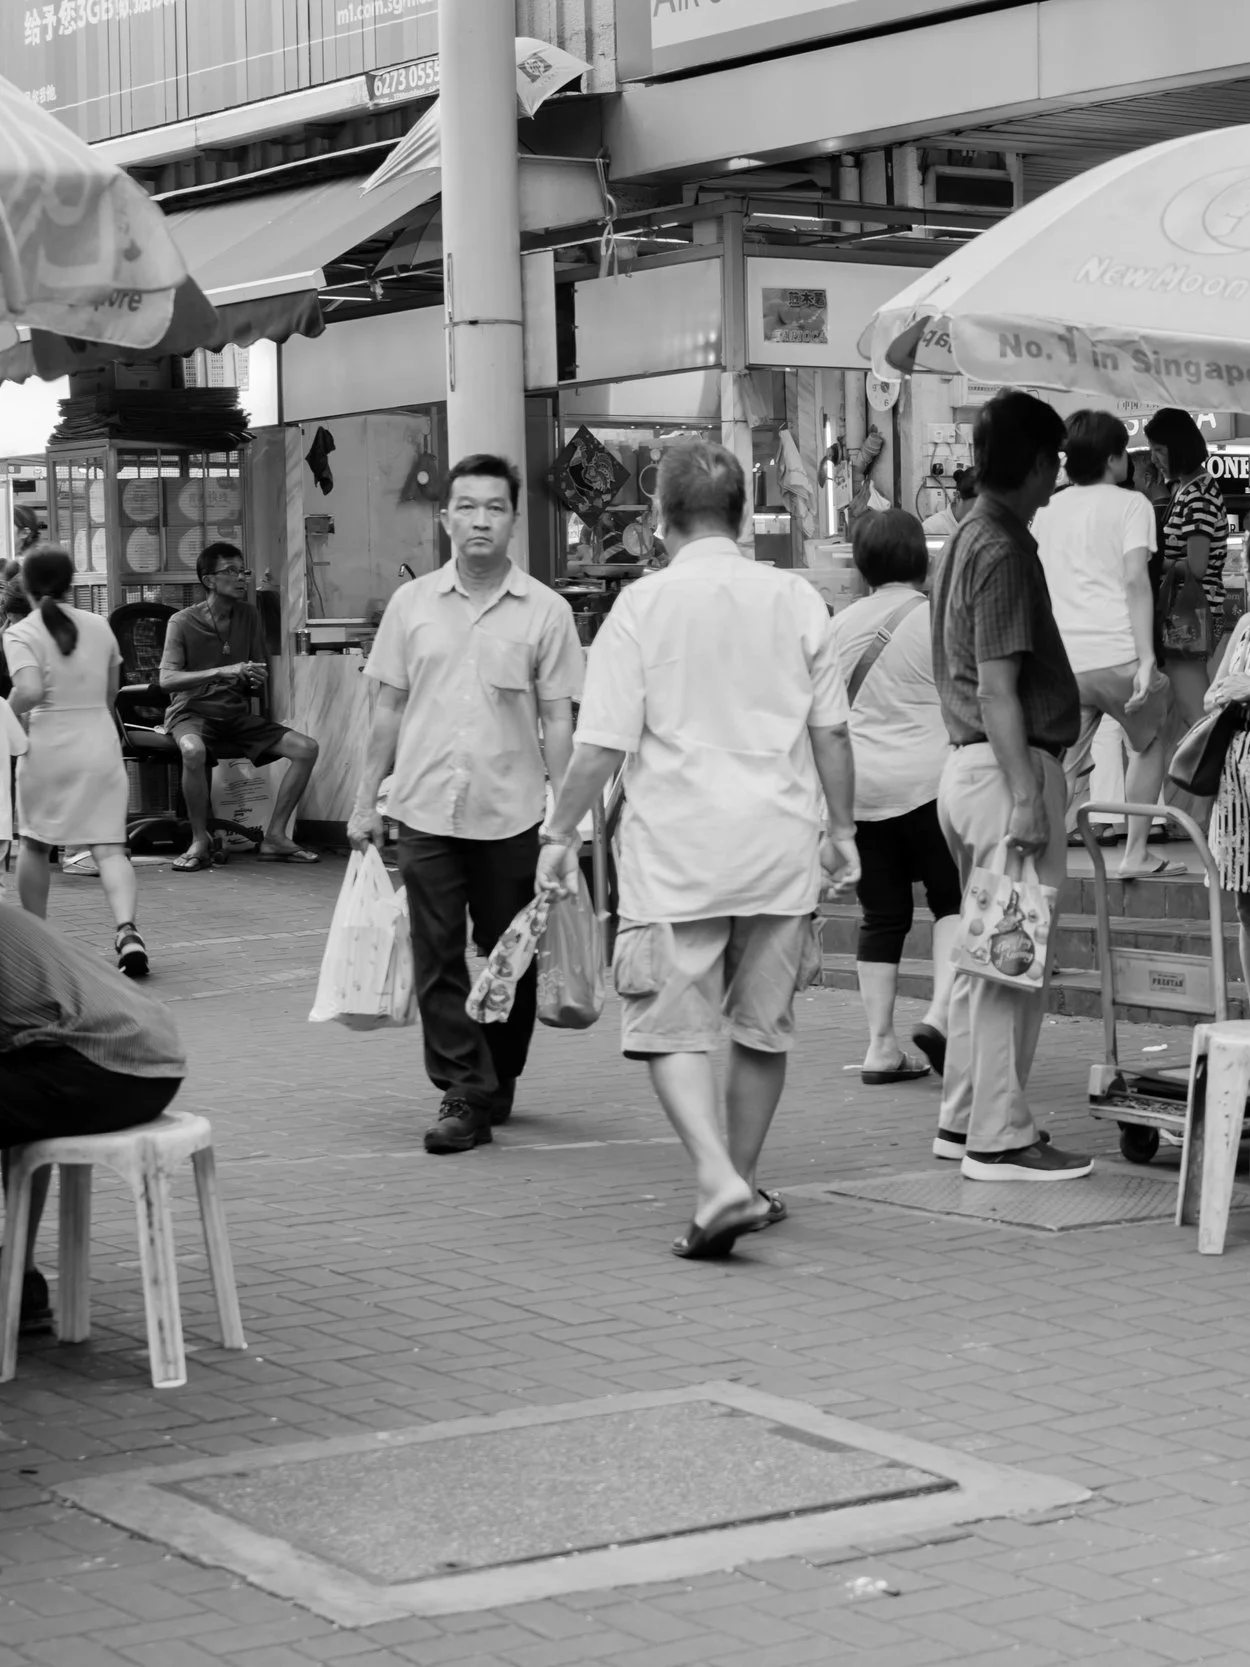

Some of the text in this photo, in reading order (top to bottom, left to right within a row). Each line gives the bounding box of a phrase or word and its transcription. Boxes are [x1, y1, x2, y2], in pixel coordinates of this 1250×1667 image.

[374, 59, 440, 97] 6273 0555
[1000, 332, 1053, 361] No.
[1092, 352, 1119, 372] in
[1201, 455, 1250, 479] ONE
